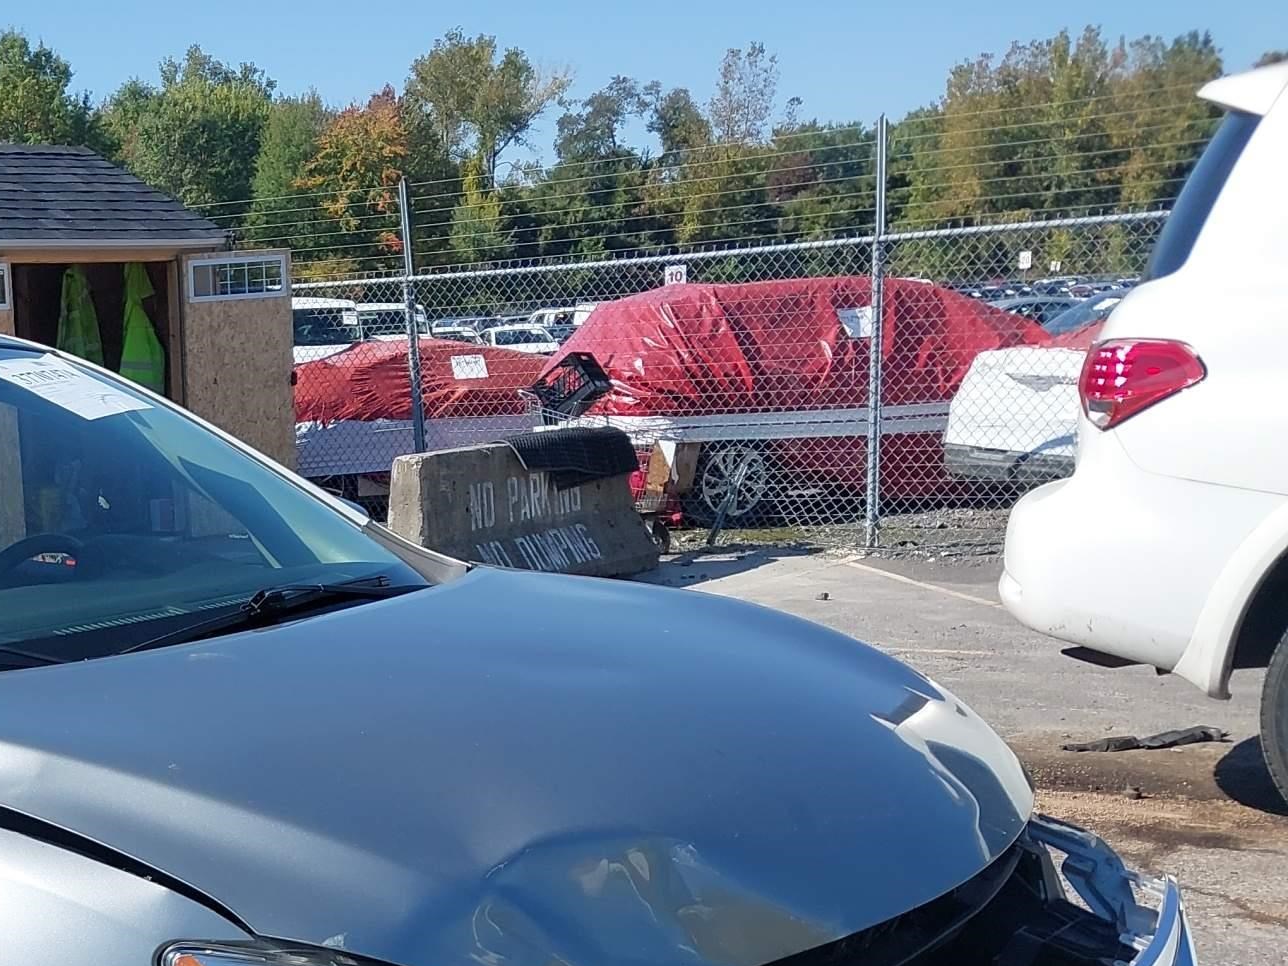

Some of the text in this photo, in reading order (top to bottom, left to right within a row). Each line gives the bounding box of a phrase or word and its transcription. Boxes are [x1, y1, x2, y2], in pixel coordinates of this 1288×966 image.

[668, 270, 683, 283] 10
[469, 482, 495, 531] NO
[514, 523, 602, 571] DUMPING
